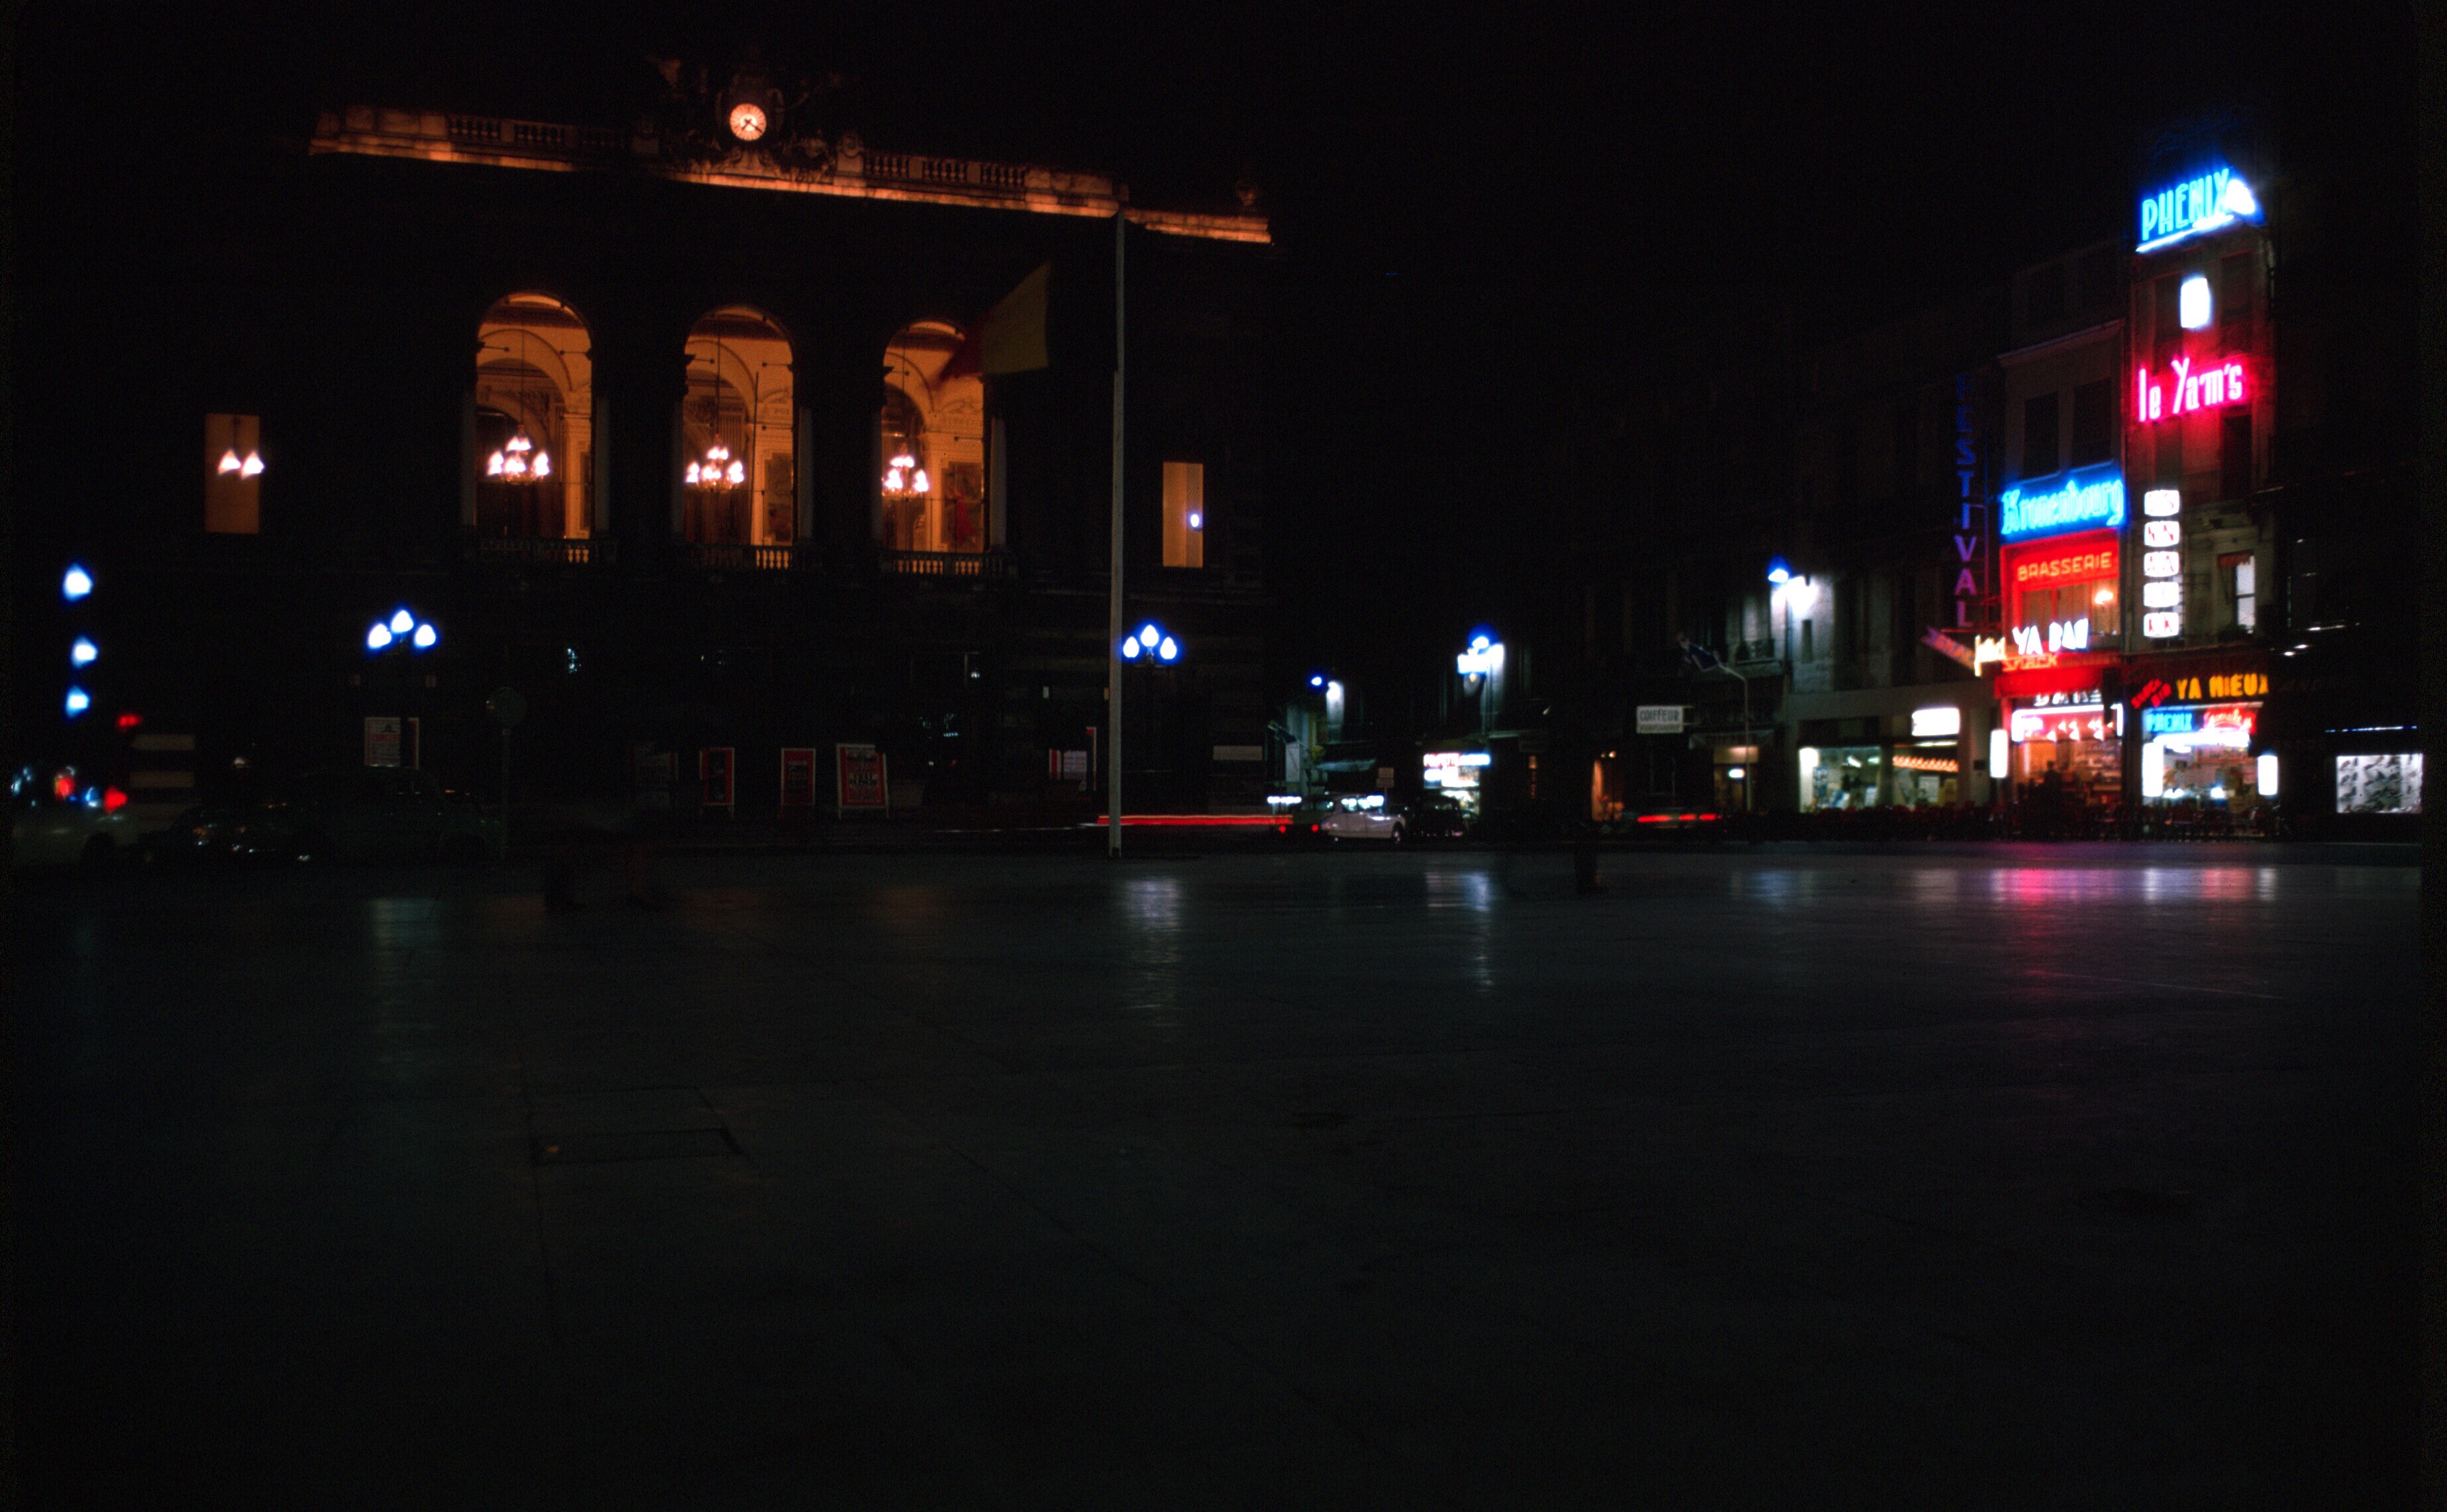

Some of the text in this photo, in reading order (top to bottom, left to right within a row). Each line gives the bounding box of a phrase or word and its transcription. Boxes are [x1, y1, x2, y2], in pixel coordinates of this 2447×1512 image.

[2142, 168, 2232, 241] PHENIX
[2139, 357, 2243, 422] le Yam's
[1953, 375, 1977, 627] FESTIVAL
[2001, 479, 2124, 535] Kronenbourg
[2017, 551, 2112, 582] BRASSERIE
[2012, 625, 2044, 655] YA
[2176, 680, 2202, 700] YA
[2209, 673, 2269, 699] MIEUX
[1640, 709, 1679, 721] COIFFEUR
